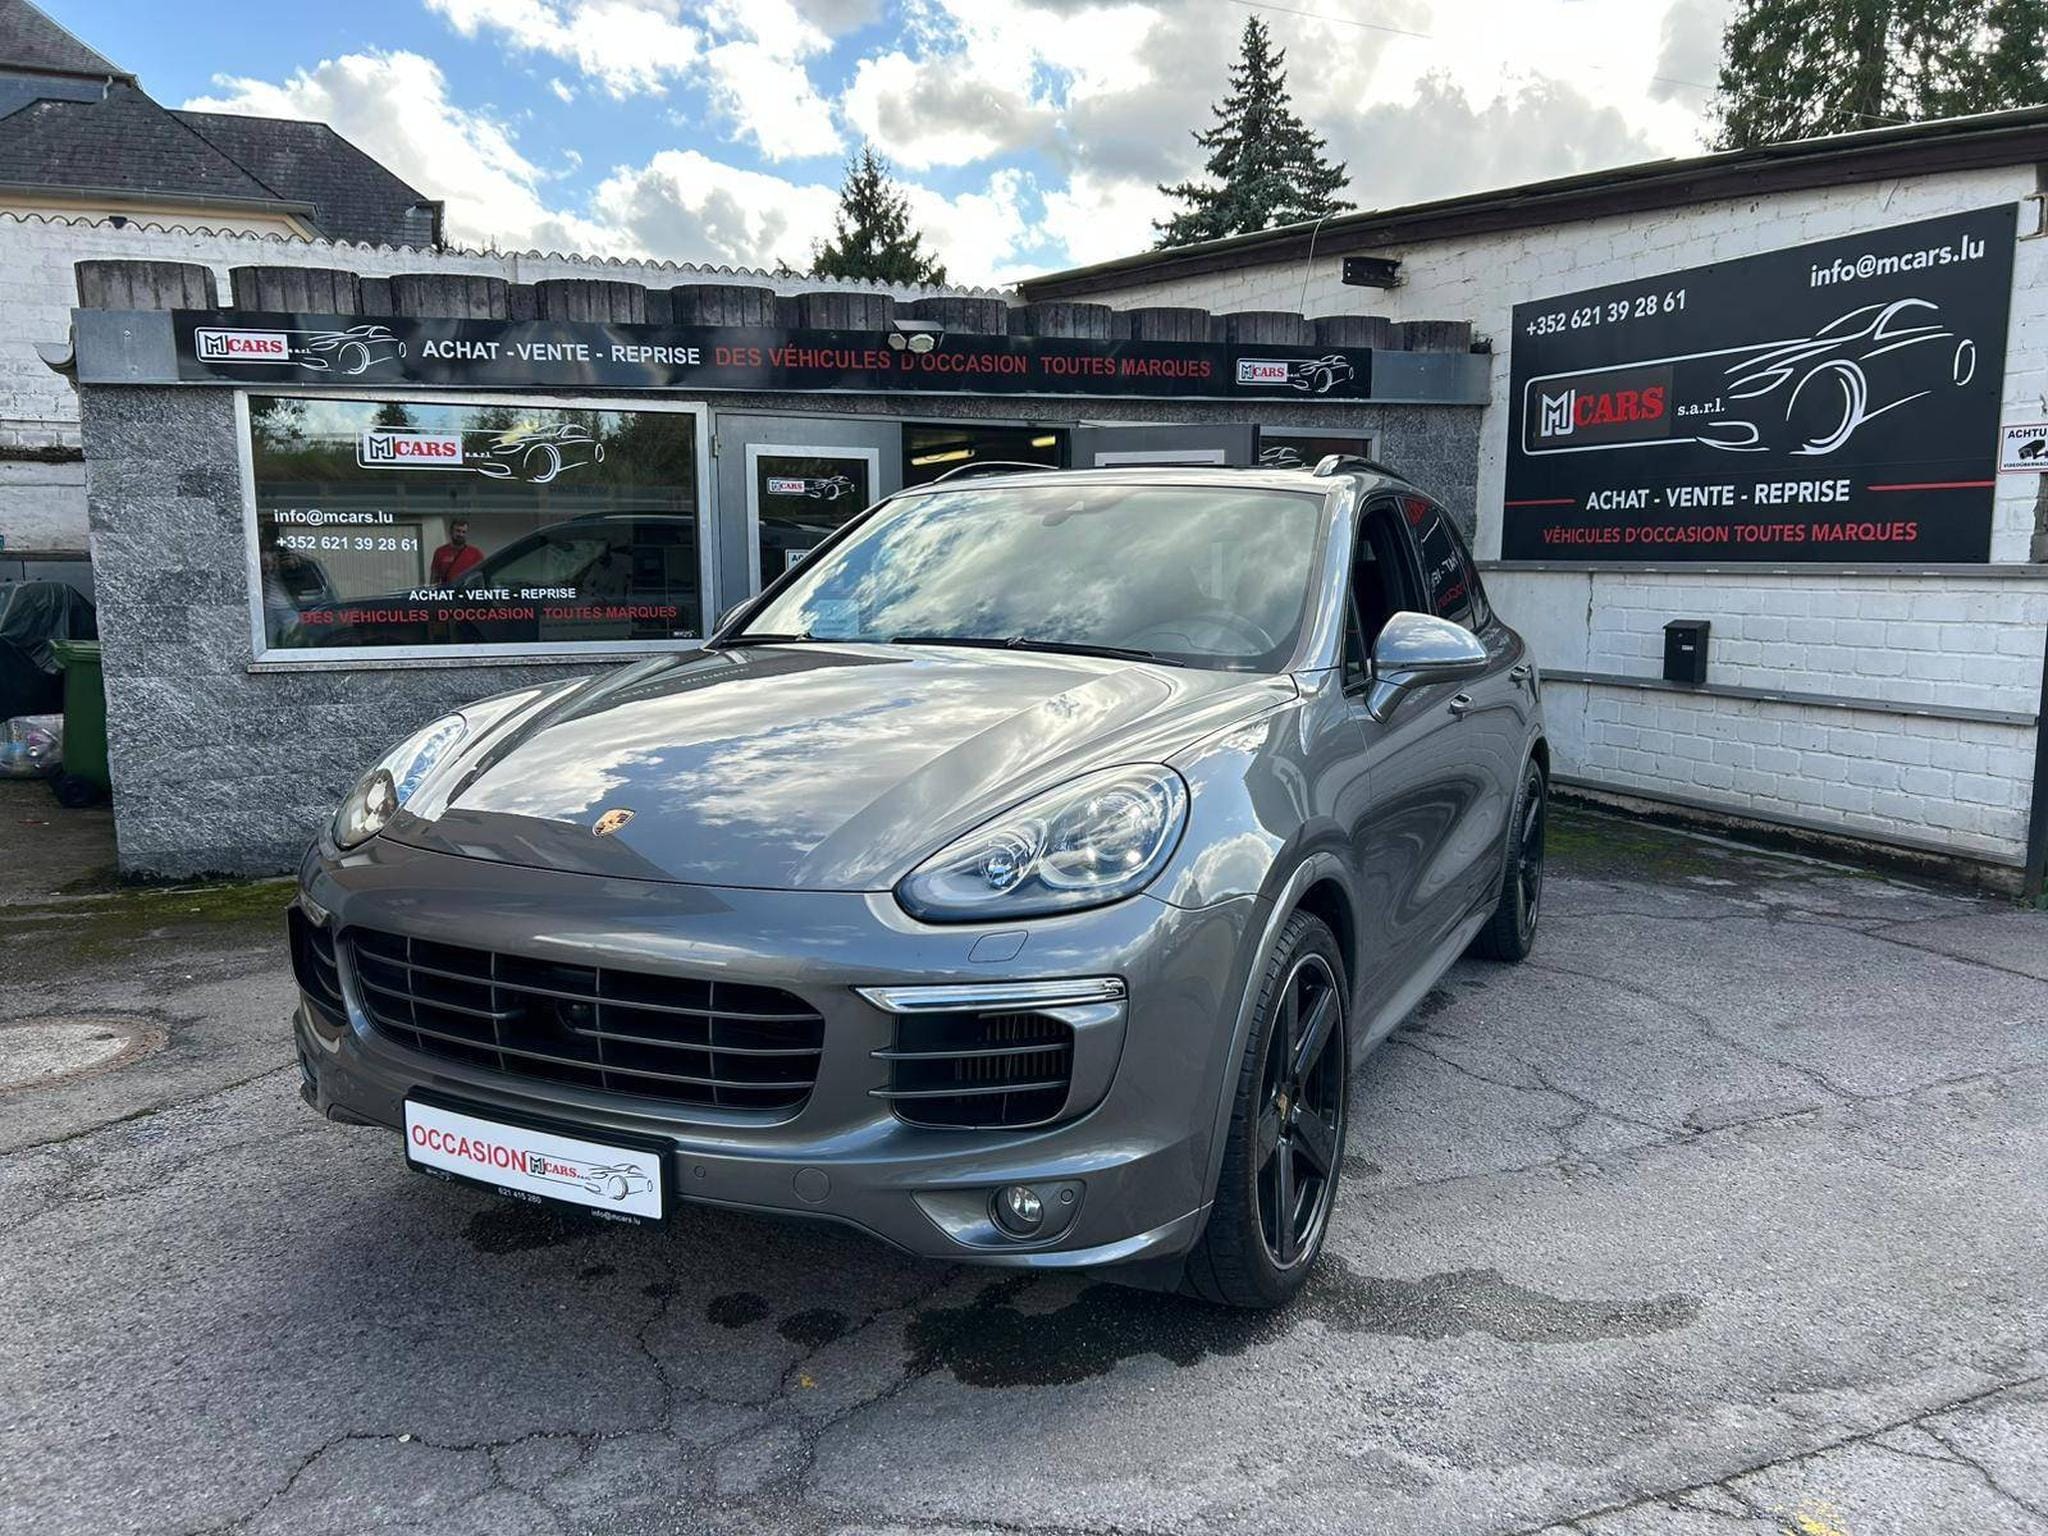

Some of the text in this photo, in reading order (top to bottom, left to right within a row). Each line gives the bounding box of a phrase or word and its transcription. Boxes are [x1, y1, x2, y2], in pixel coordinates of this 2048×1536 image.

[1810, 234, 1985, 287] info@mcars.lu
[1526, 289, 1686, 336] +352 621 39 28 61
[422, 340, 500, 360] ACHAT
[611, 345, 700, 365] REPRISE
[715, 347, 762, 367] DES
[768, 344, 891, 369] VÉHICULES
[901, 352, 1027, 374] D'OCCASION
[1040, 356, 1117, 375] TOUTES
[1121, 358, 1211, 377] MARQUES
[1585, 489, 1650, 510] ACHAT
[1666, 485, 1735, 507] VENTE
[1754, 480, 1851, 504] REPRISE
[273, 509, 394, 526] info@mcars.lu
[276, 535, 418, 551] +352 621 39 28 61
[1543, 522, 1918, 544] VÉHICULES D'OCCASION TOUTES MARQUES
[409, 590, 455, 601] ACHAT
[465, 589, 511, 601] VENTE
[521, 588, 577, 600] REPRISE
[302, 611, 333, 624] DES
[438, 607, 534, 622] D'OCCASION
[543, 607, 602, 620] TOUTES
[606, 606, 677, 619] MARQUES
[412, 1124, 527, 1173] OCCASION
